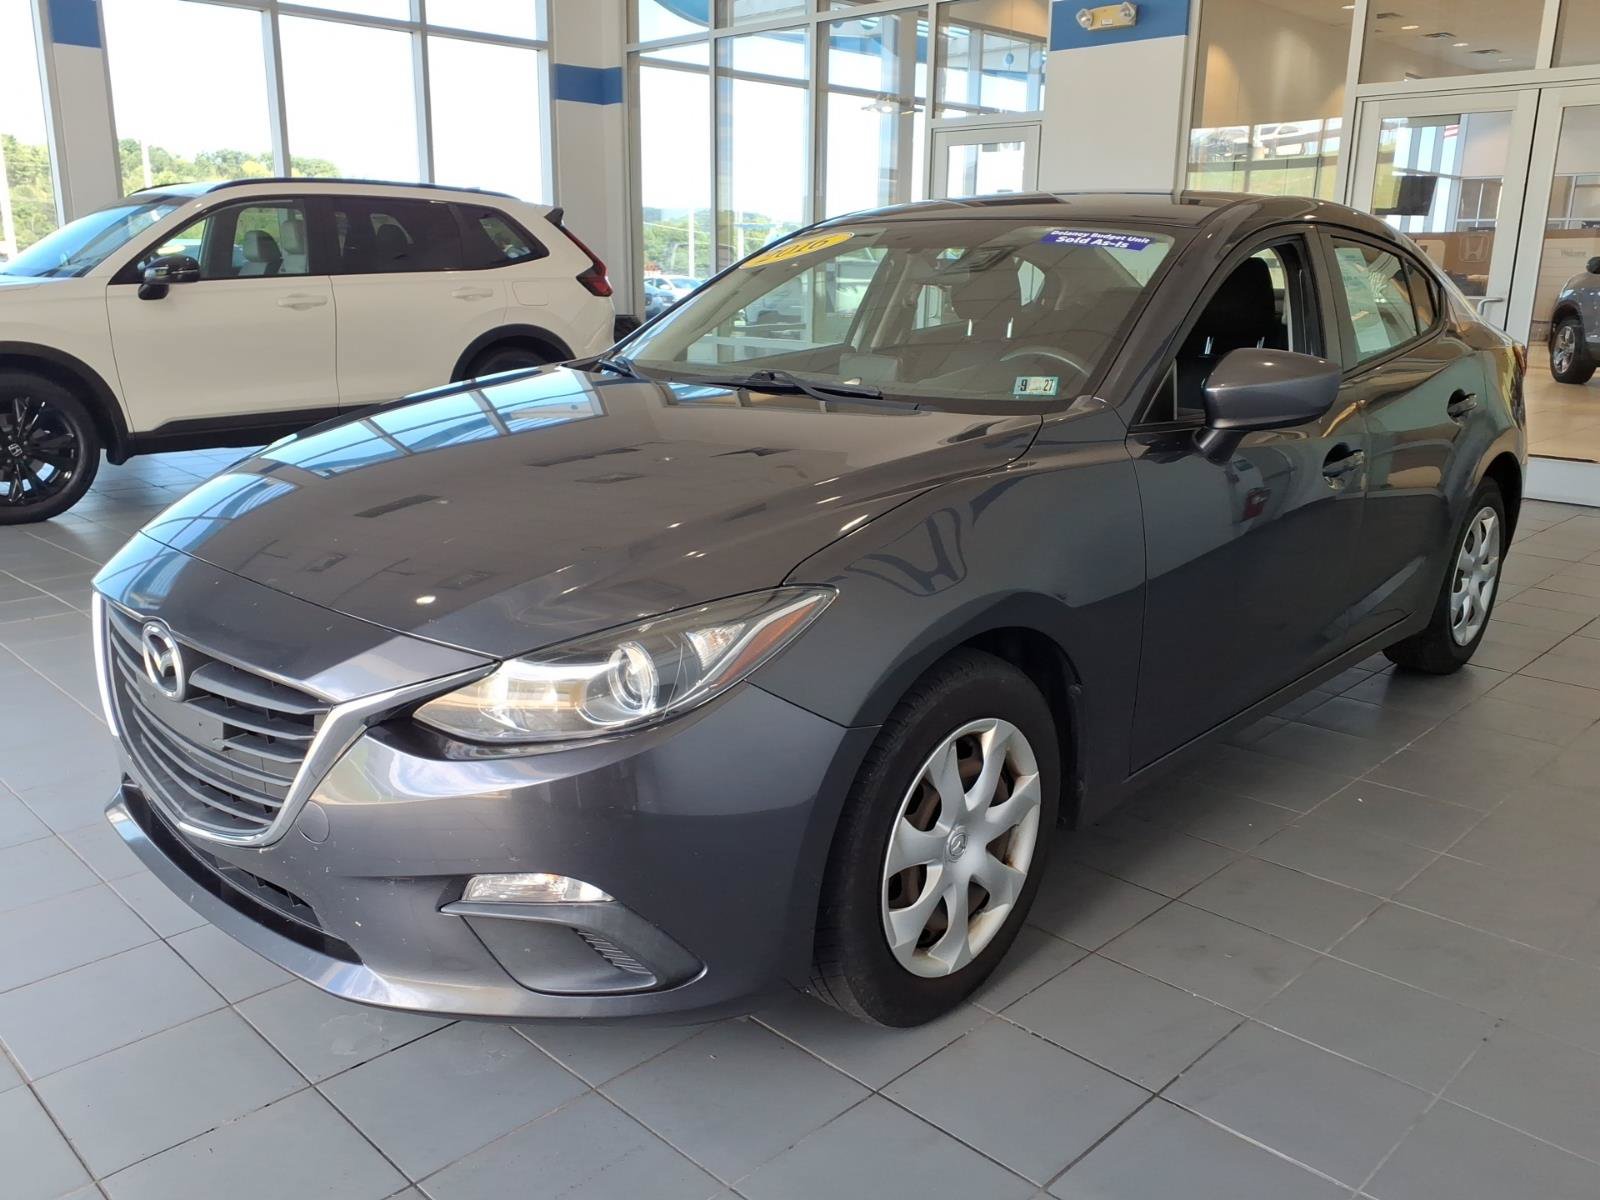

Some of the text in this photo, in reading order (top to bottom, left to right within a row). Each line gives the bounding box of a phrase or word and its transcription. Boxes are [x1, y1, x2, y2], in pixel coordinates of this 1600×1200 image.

[1055, 236, 1129, 248] Sold As-Is
[1090, 232, 1127, 241] Budget
[1127, 235, 1150, 244] Unit
[1020, 379, 1053, 391] 9 27
